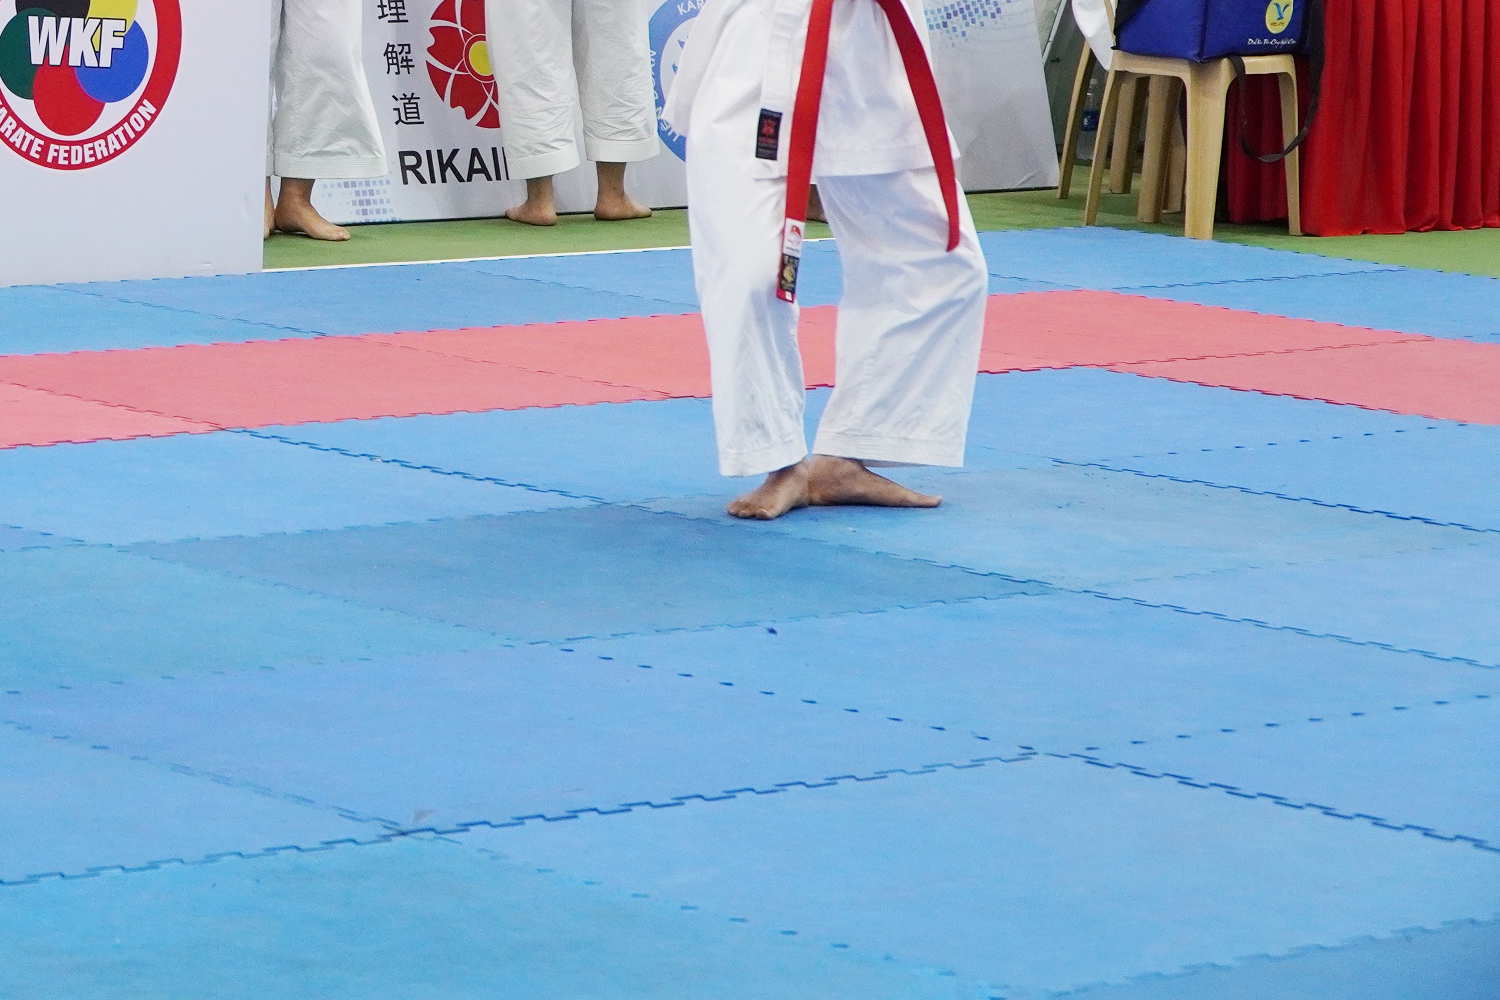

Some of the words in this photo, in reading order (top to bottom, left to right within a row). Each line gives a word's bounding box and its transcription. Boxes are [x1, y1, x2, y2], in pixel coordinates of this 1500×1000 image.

[27, 15, 127, 69] WKF
[46, 98, 157, 166] FEDERATION
[398, 146, 510, 186] RIKAI
